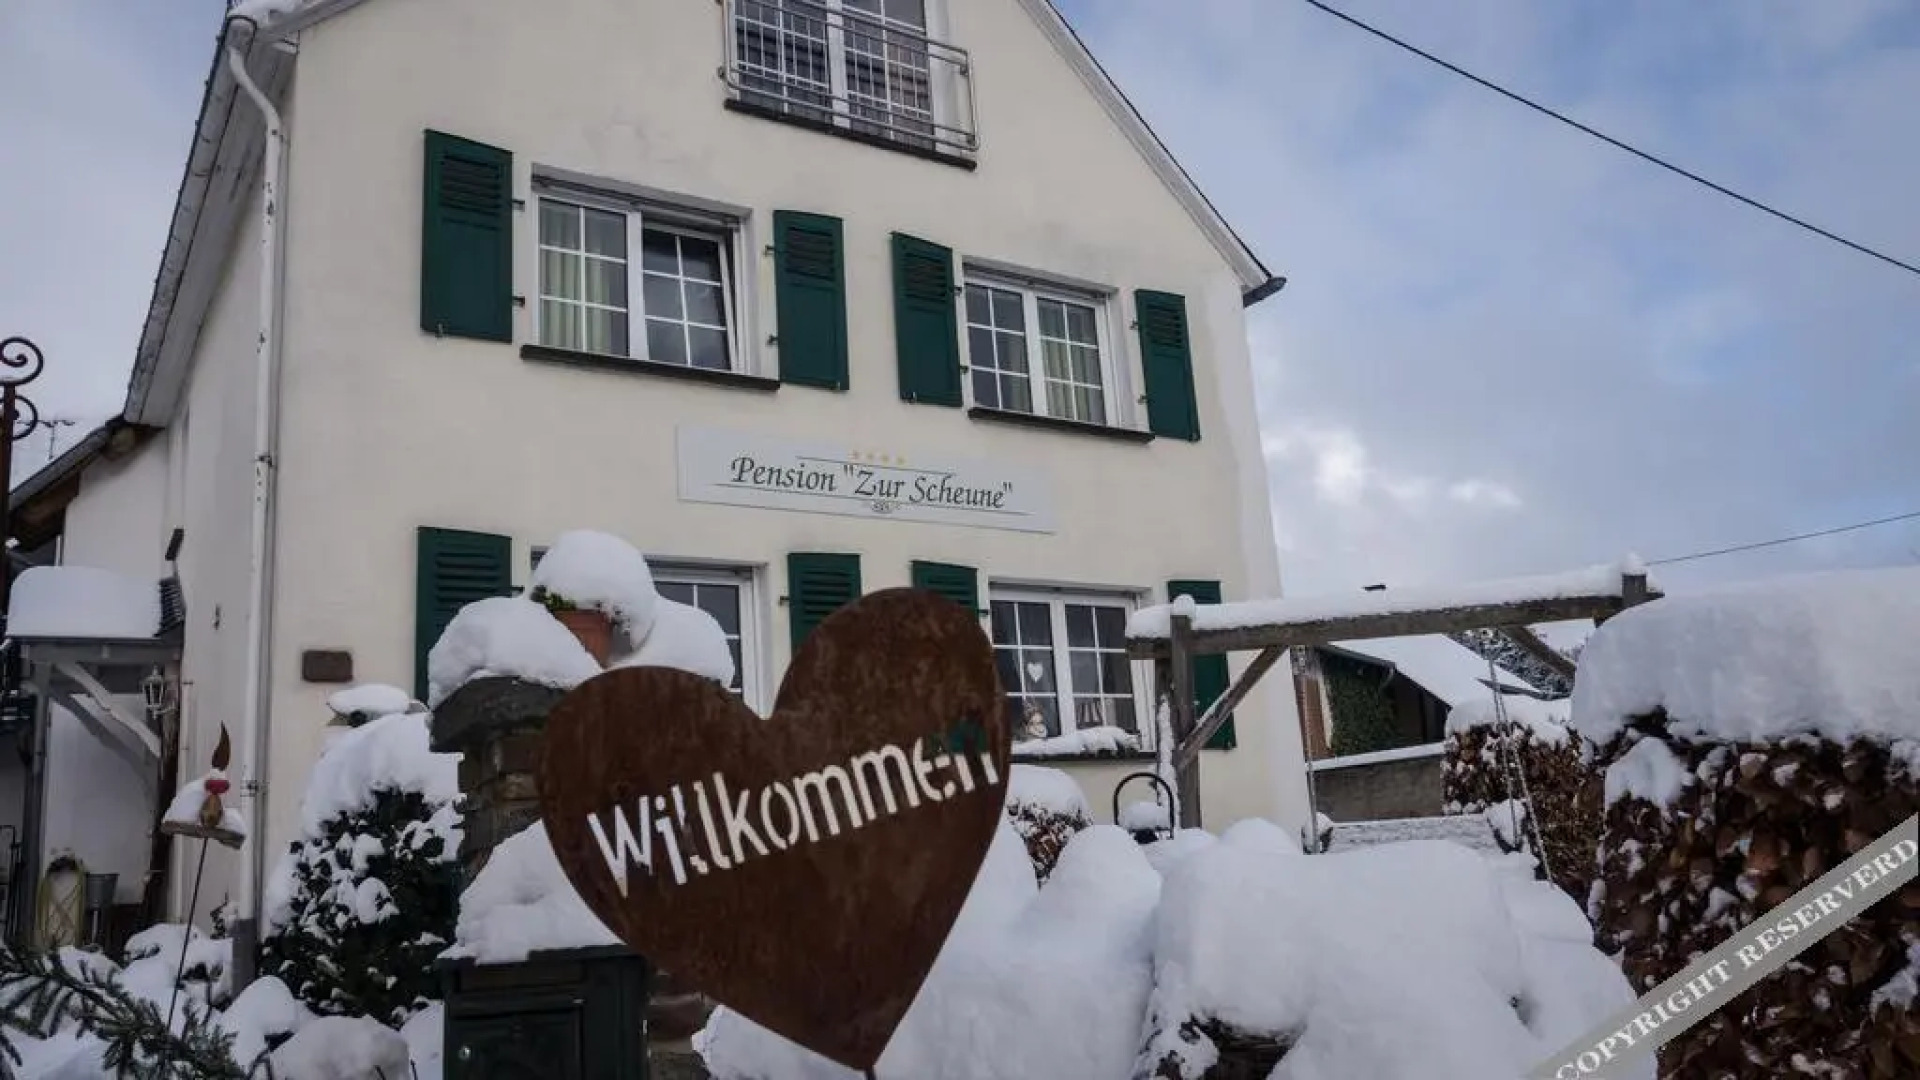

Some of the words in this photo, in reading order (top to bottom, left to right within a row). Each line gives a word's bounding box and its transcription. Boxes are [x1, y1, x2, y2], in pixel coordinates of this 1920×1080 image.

[730, 456, 836, 492] Pension
[843, 465, 905, 498] "Zur
[908, 474, 1013, 508] Scheune"
[587, 720, 999, 898] Willkommen
